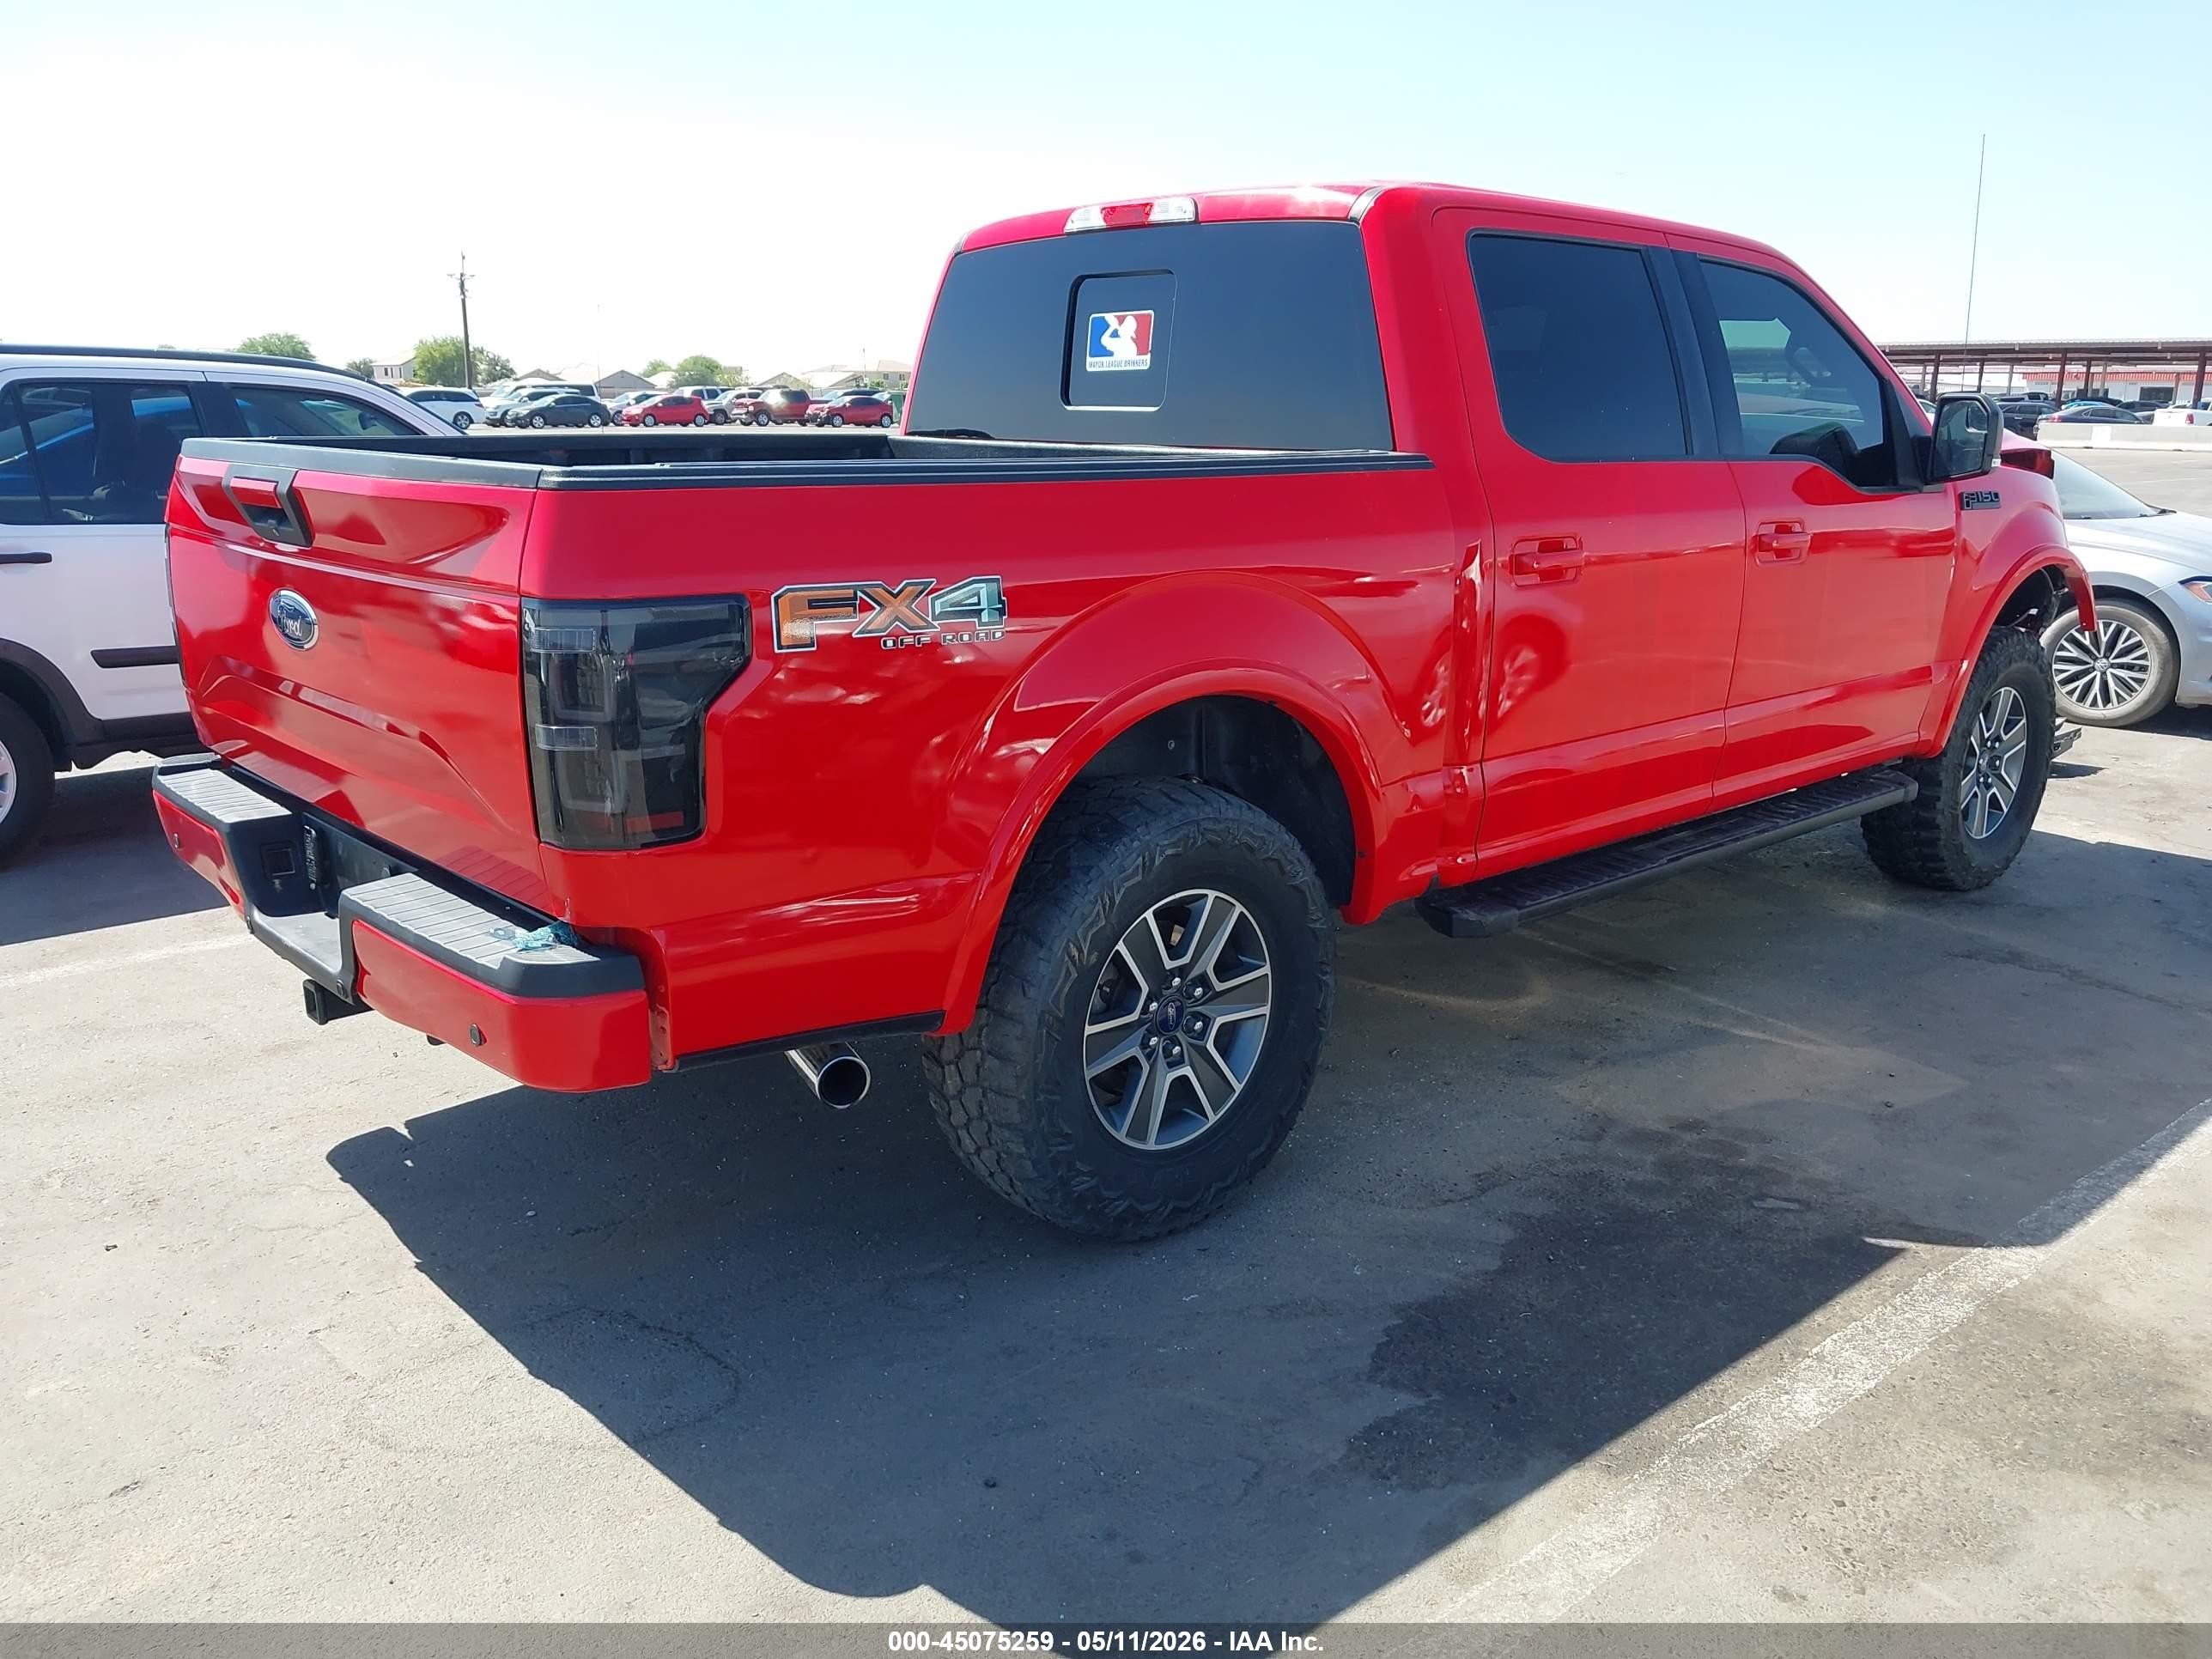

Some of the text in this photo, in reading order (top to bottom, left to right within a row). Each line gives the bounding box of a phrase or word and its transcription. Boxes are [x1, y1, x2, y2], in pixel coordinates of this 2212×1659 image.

[1105, 359, 1122, 368] LEAGUE
[1124, 358, 1148, 368] DRINKERS
[771, 575, 1007, 653] FX4
[880, 629, 1006, 650] OFF ROAD
